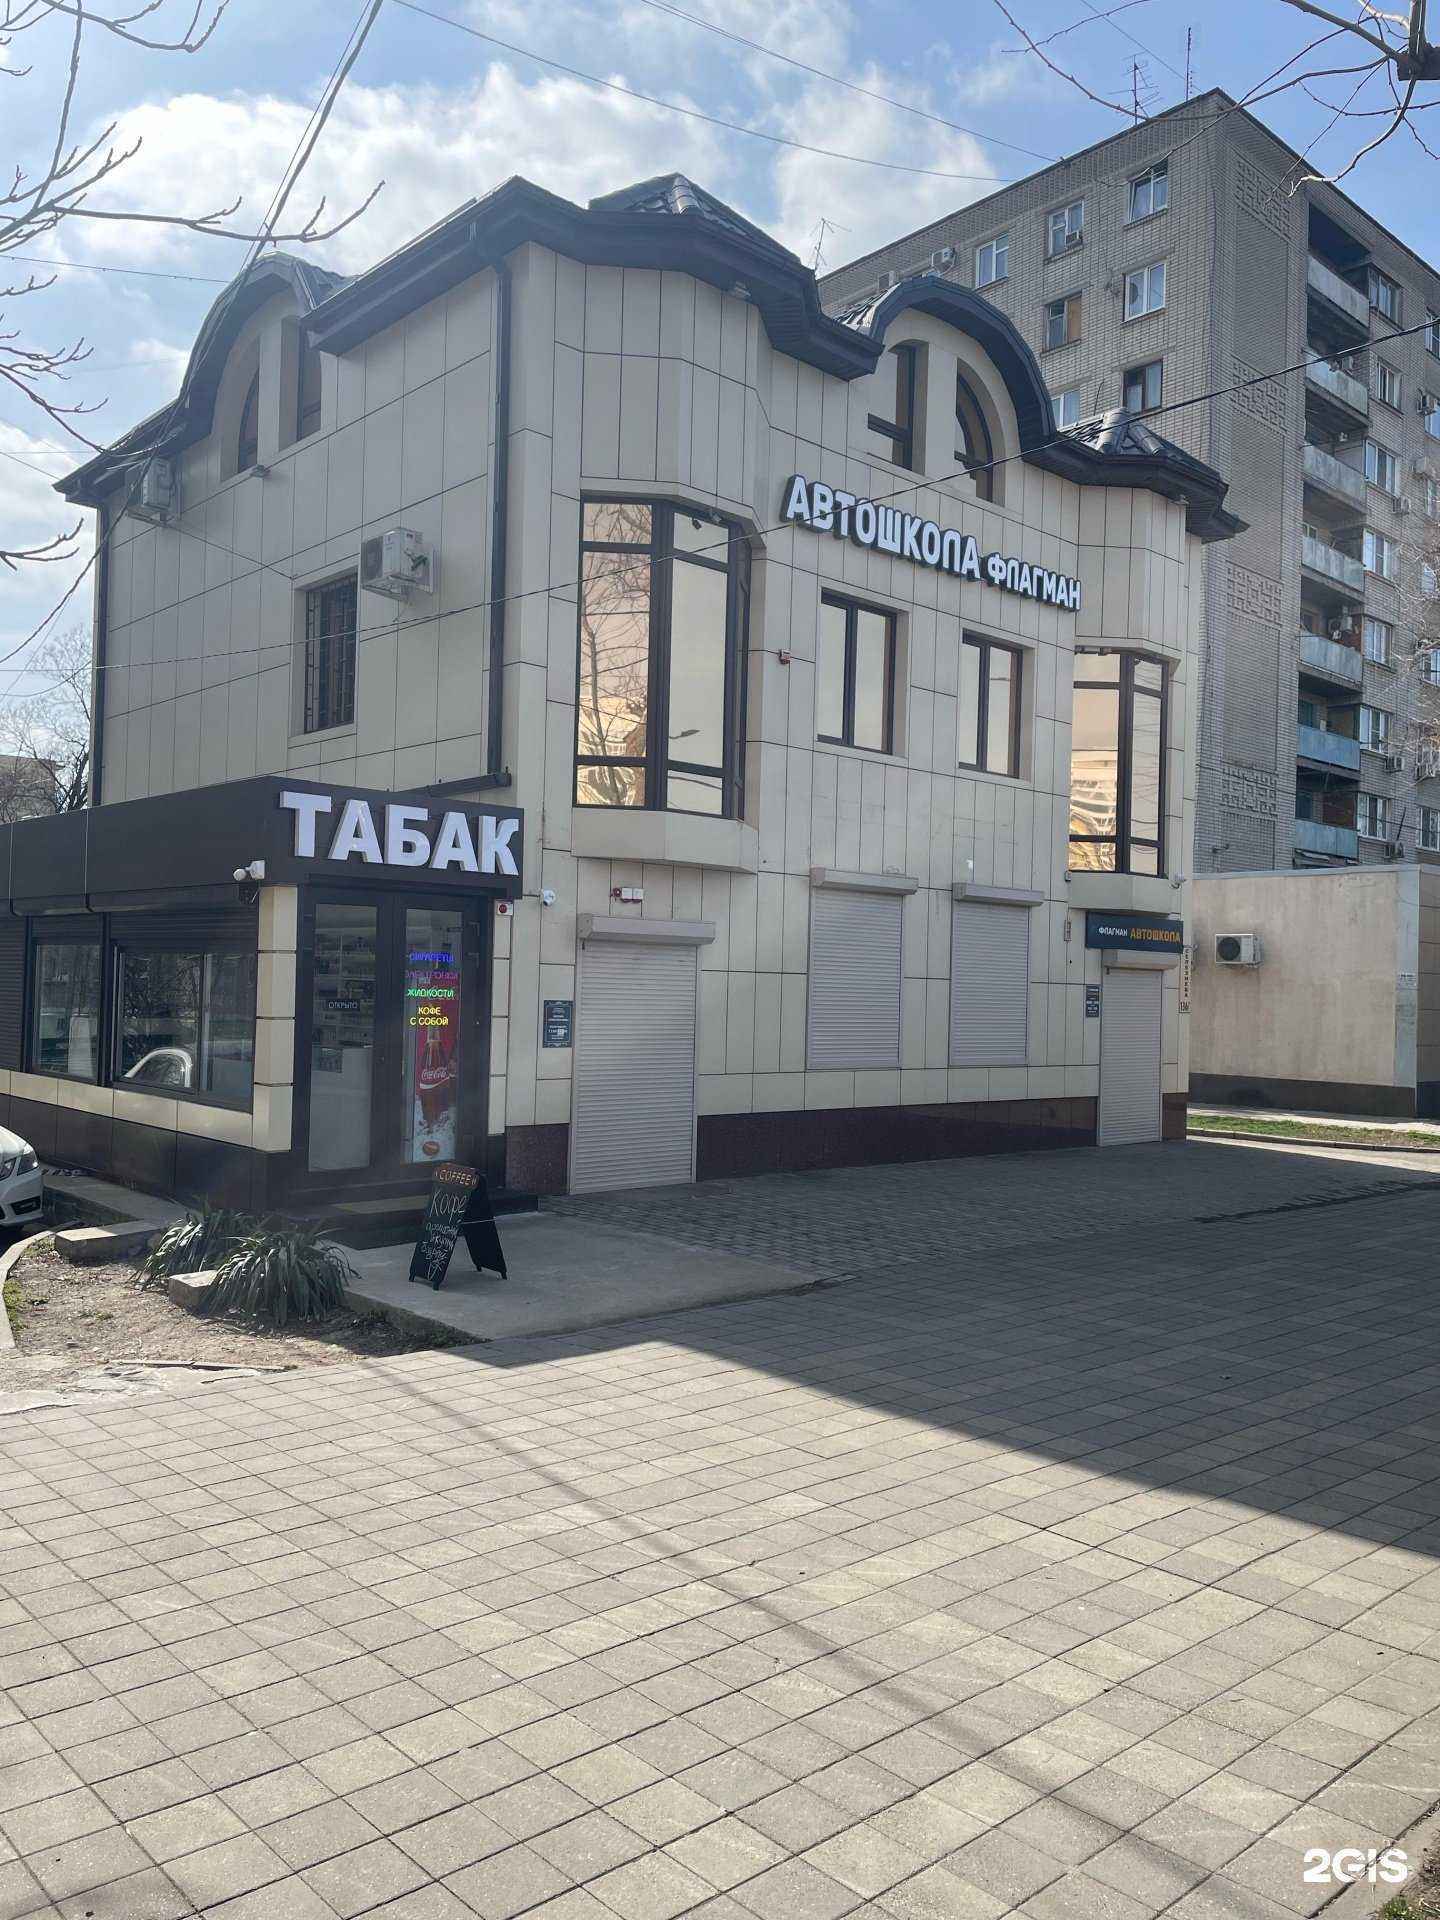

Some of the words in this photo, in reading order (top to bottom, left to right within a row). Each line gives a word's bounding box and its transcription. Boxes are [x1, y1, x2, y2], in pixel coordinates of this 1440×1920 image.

[280, 791, 520, 875] ТАБАК
[418, 1006, 441, 1015] КОФЕ
[418, 1016, 449, 1026] СОБОЙ
[440, 1169, 472, 1186] COFFEE
